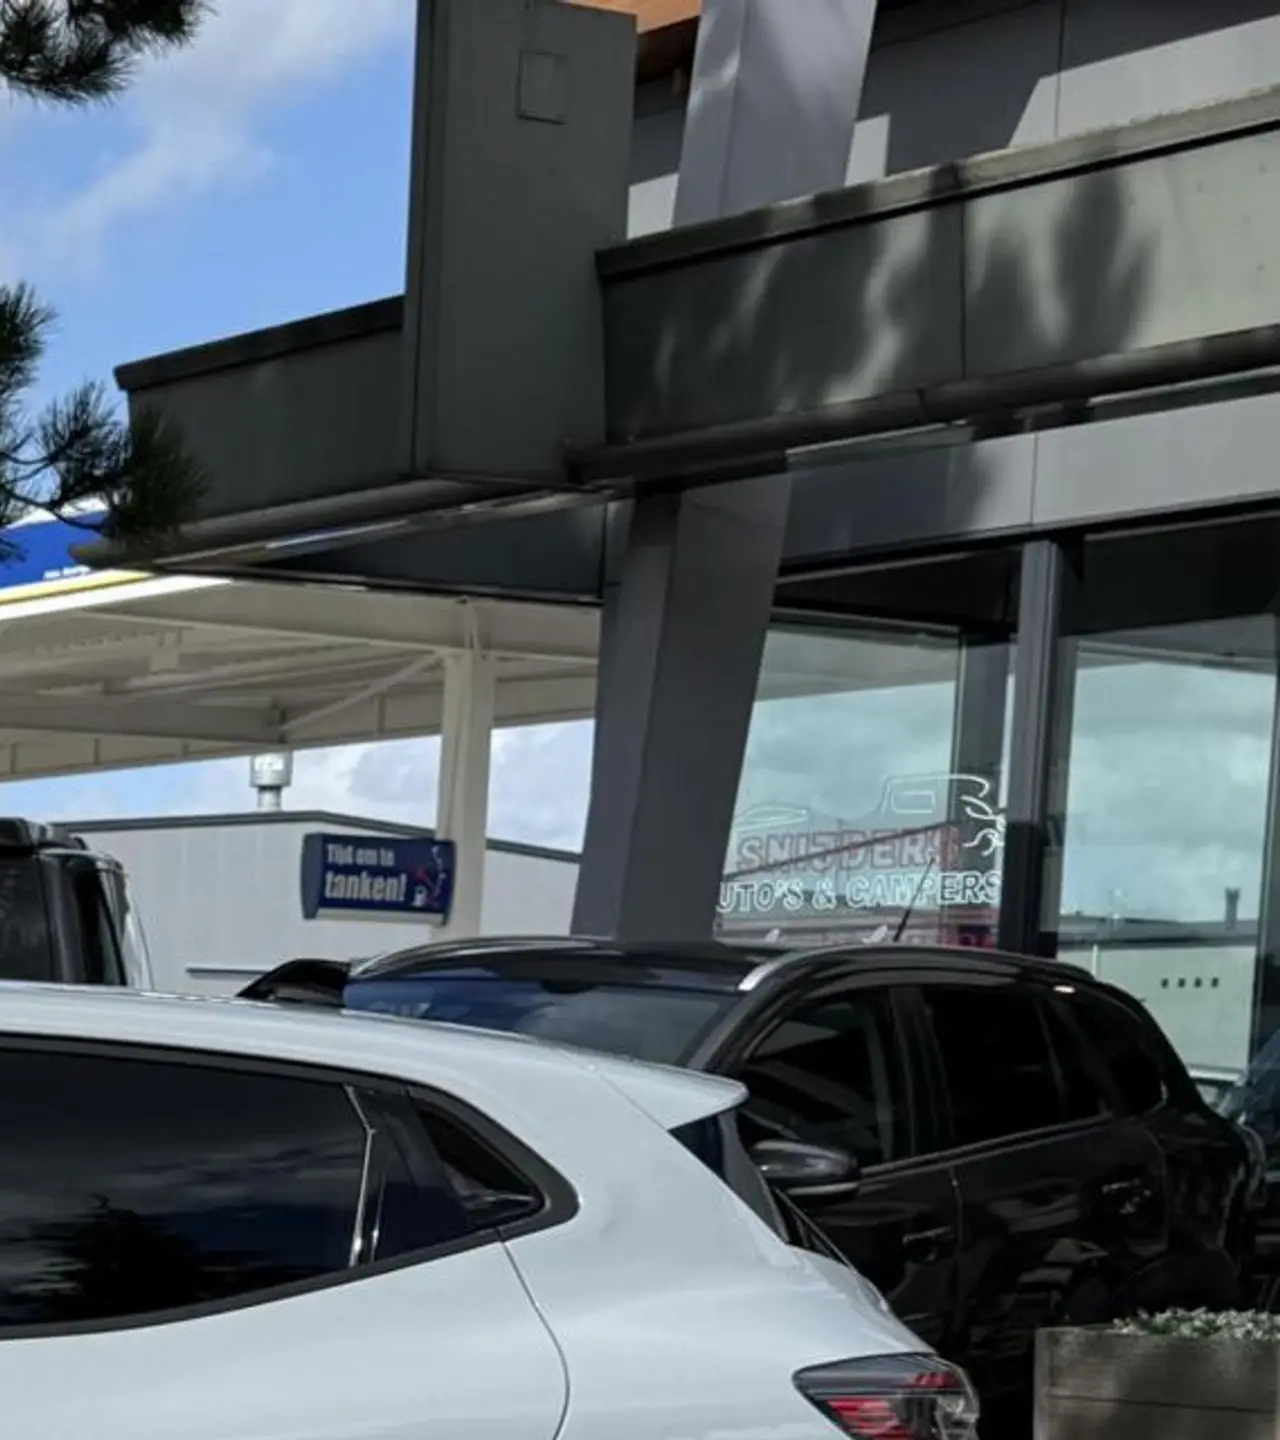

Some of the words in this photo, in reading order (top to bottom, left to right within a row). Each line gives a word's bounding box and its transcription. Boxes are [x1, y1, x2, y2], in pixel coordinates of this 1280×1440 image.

[736, 827, 960, 872] SNIJDERS
[325, 870, 407, 901] tanken!
[717, 880, 804, 914] UTO'S
[812, 877, 838, 911] &
[844, 870, 1001, 909] CAMPERS
